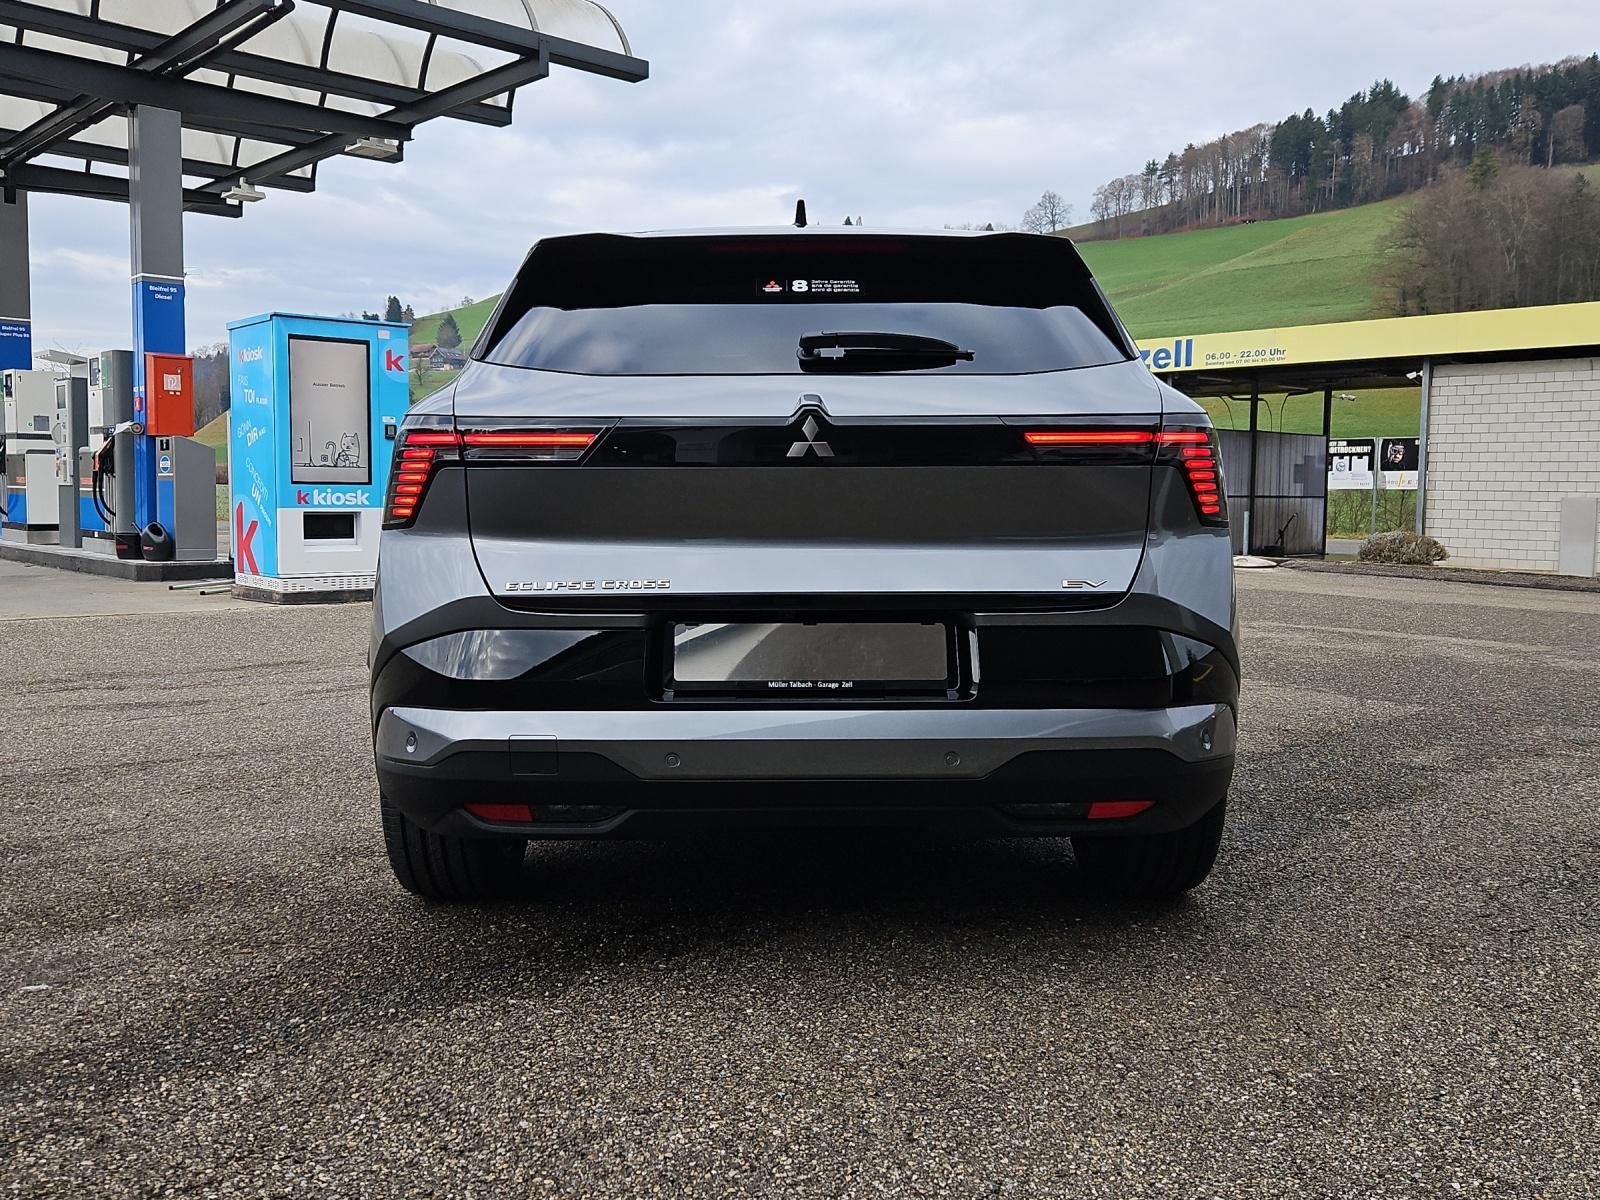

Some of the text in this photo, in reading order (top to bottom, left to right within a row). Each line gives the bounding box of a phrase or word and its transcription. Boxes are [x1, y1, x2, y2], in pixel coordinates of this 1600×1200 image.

[149, 285, 169, 293] Bleifrei
[792, 280, 808, 292] 8
[1205, 352, 1231, 361] 06.00
[1240, 349, 1267, 358] 22.00
[1269, 347, 1287, 357] Uhr
[386, 349, 404, 372] k
[243, 388, 256, 404] TOI
[313, 488, 370, 505] kiosk
[505, 579, 671, 591] ECLIPSE CROSS
[1062, 579, 1108, 588] EV
[817, 681, 839, 689] Garage
